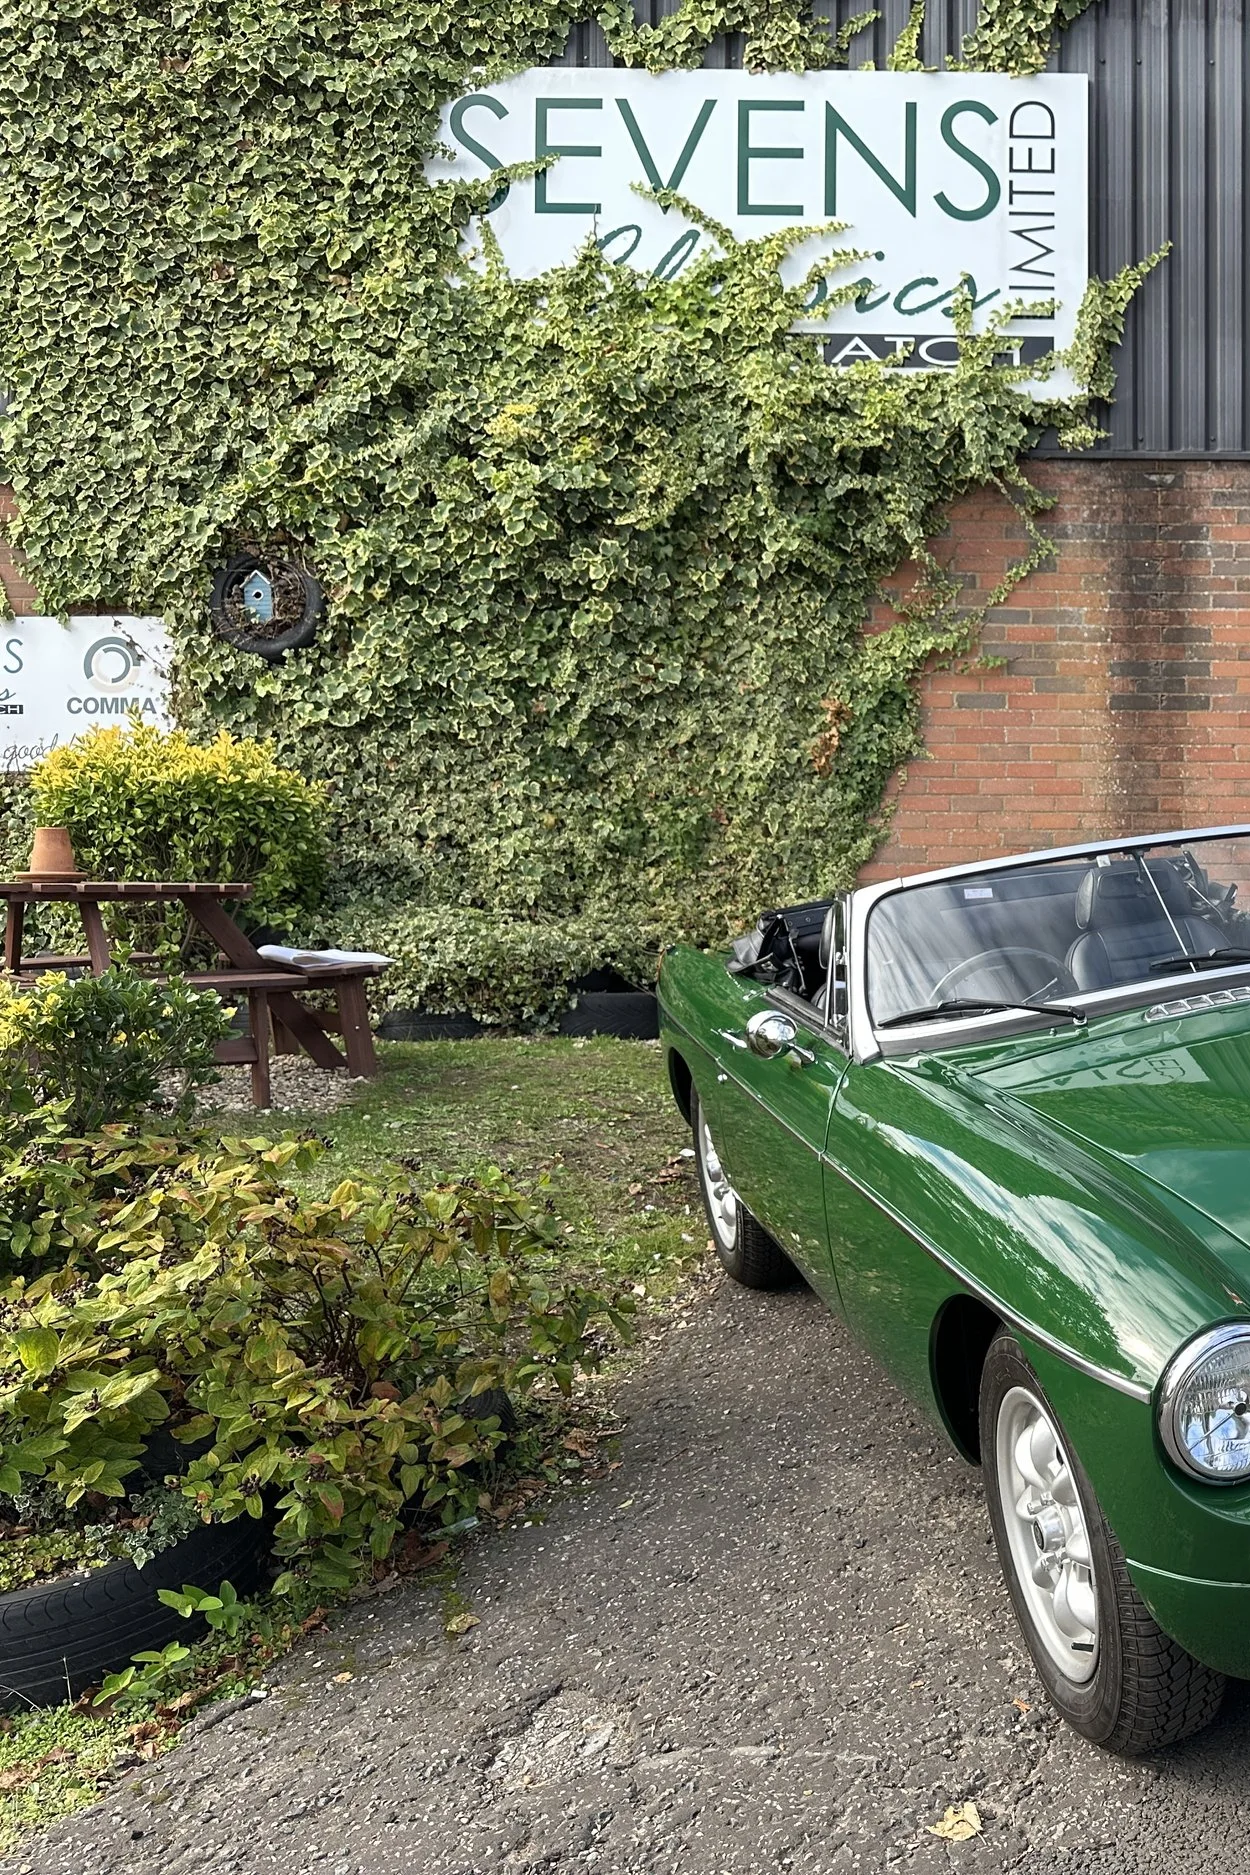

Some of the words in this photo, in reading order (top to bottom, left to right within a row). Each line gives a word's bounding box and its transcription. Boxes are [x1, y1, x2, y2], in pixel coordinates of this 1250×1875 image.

[450, 93, 1001, 221] SEVENS
[1008, 101, 1056, 320] LIMITED
[66, 696, 157, 715] COMMA
